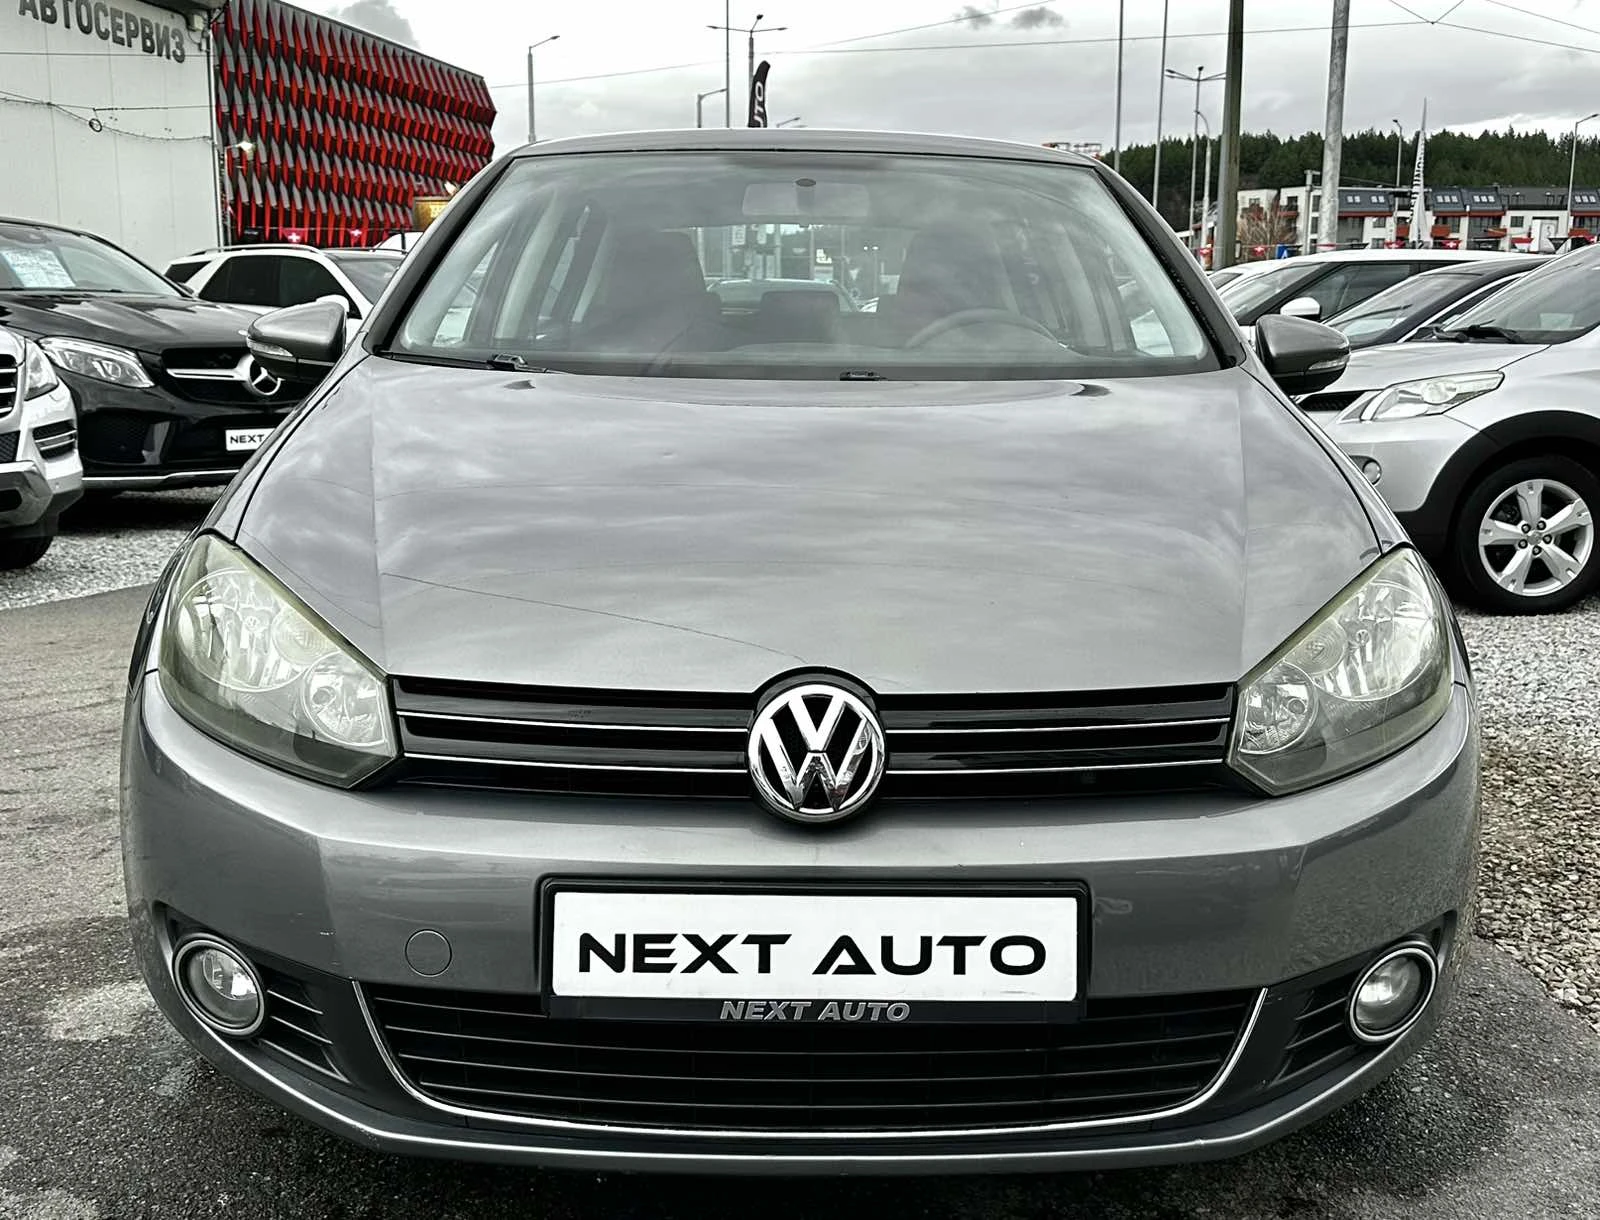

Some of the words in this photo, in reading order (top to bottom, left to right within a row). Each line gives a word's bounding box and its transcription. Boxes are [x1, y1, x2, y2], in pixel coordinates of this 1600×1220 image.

[229, 433, 265, 444] NEXT
[579, 932, 792, 974] NEXT
[812, 934, 1047, 976] AUTO
[719, 1001, 812, 1021] NEXT
[817, 1001, 911, 1022] AUTO
